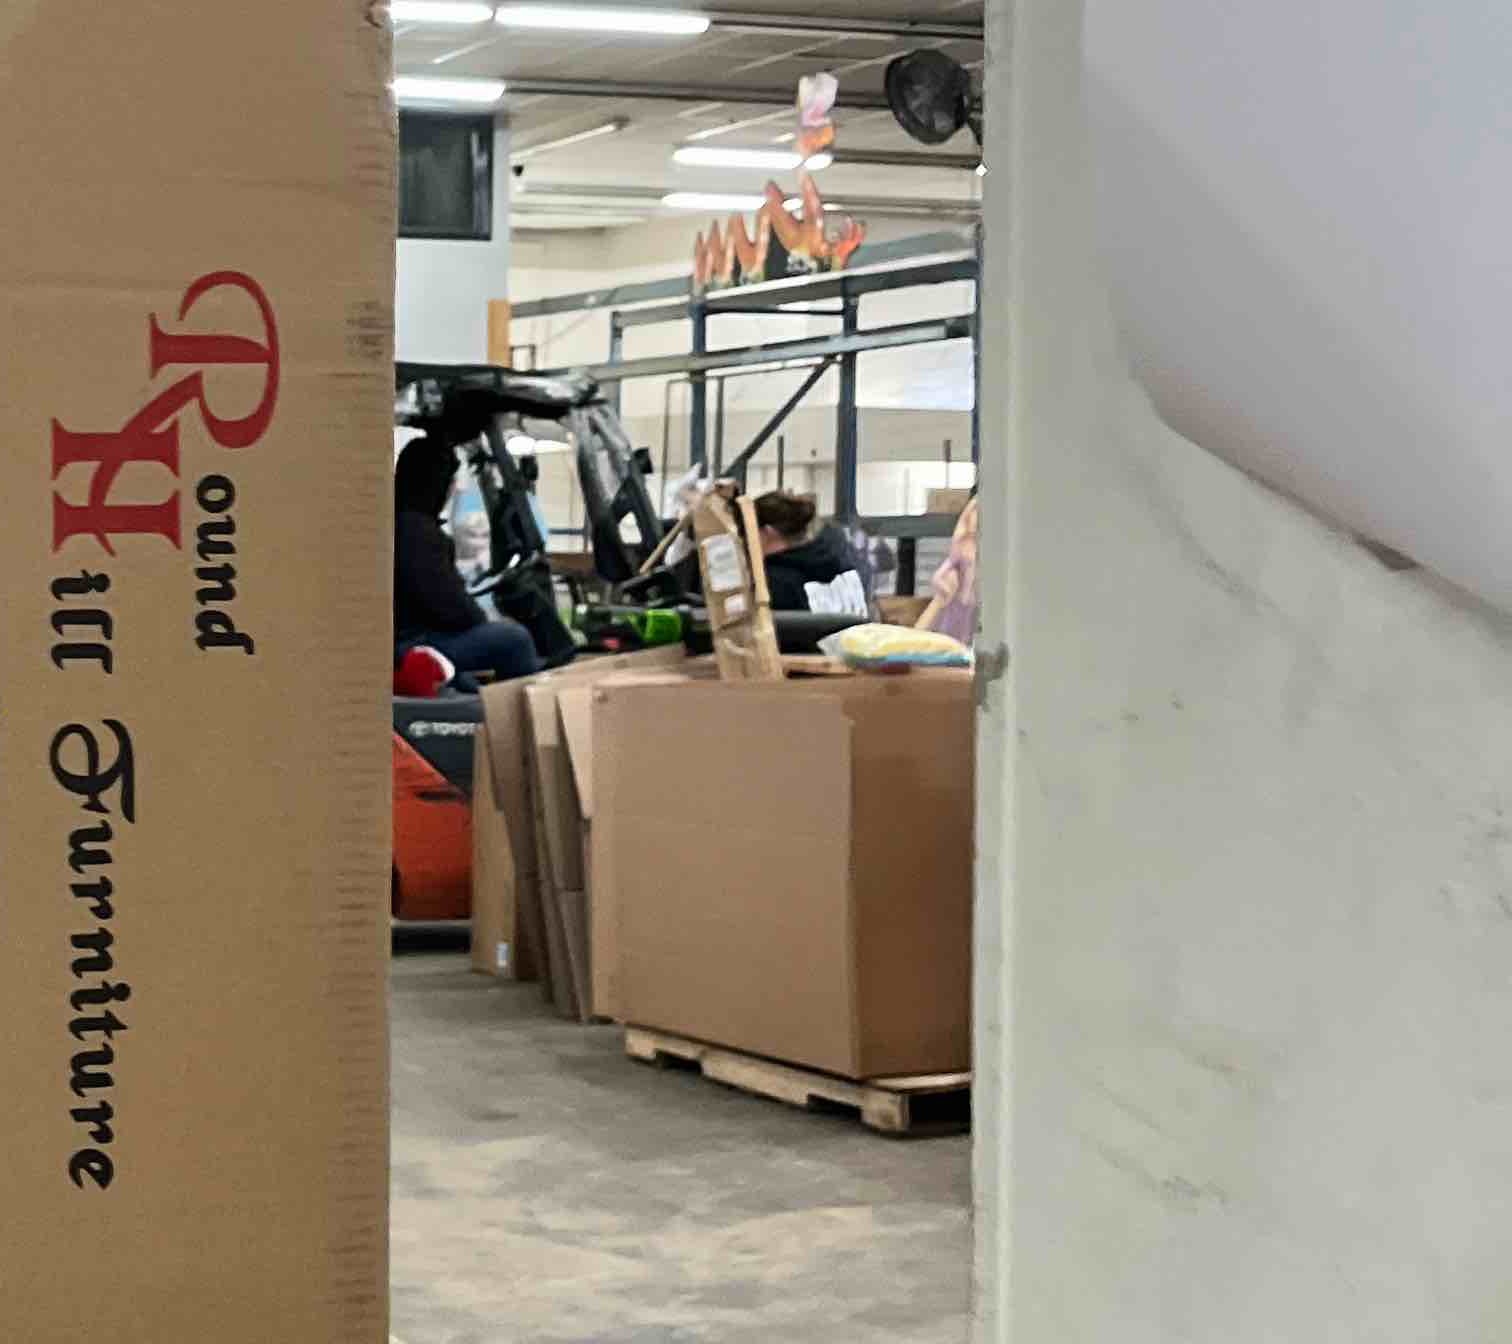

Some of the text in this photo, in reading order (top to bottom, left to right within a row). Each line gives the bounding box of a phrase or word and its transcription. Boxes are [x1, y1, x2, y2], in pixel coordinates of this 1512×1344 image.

[146, 270, 280, 656] Round
[48, 415, 183, 1191] Hill Furniture
